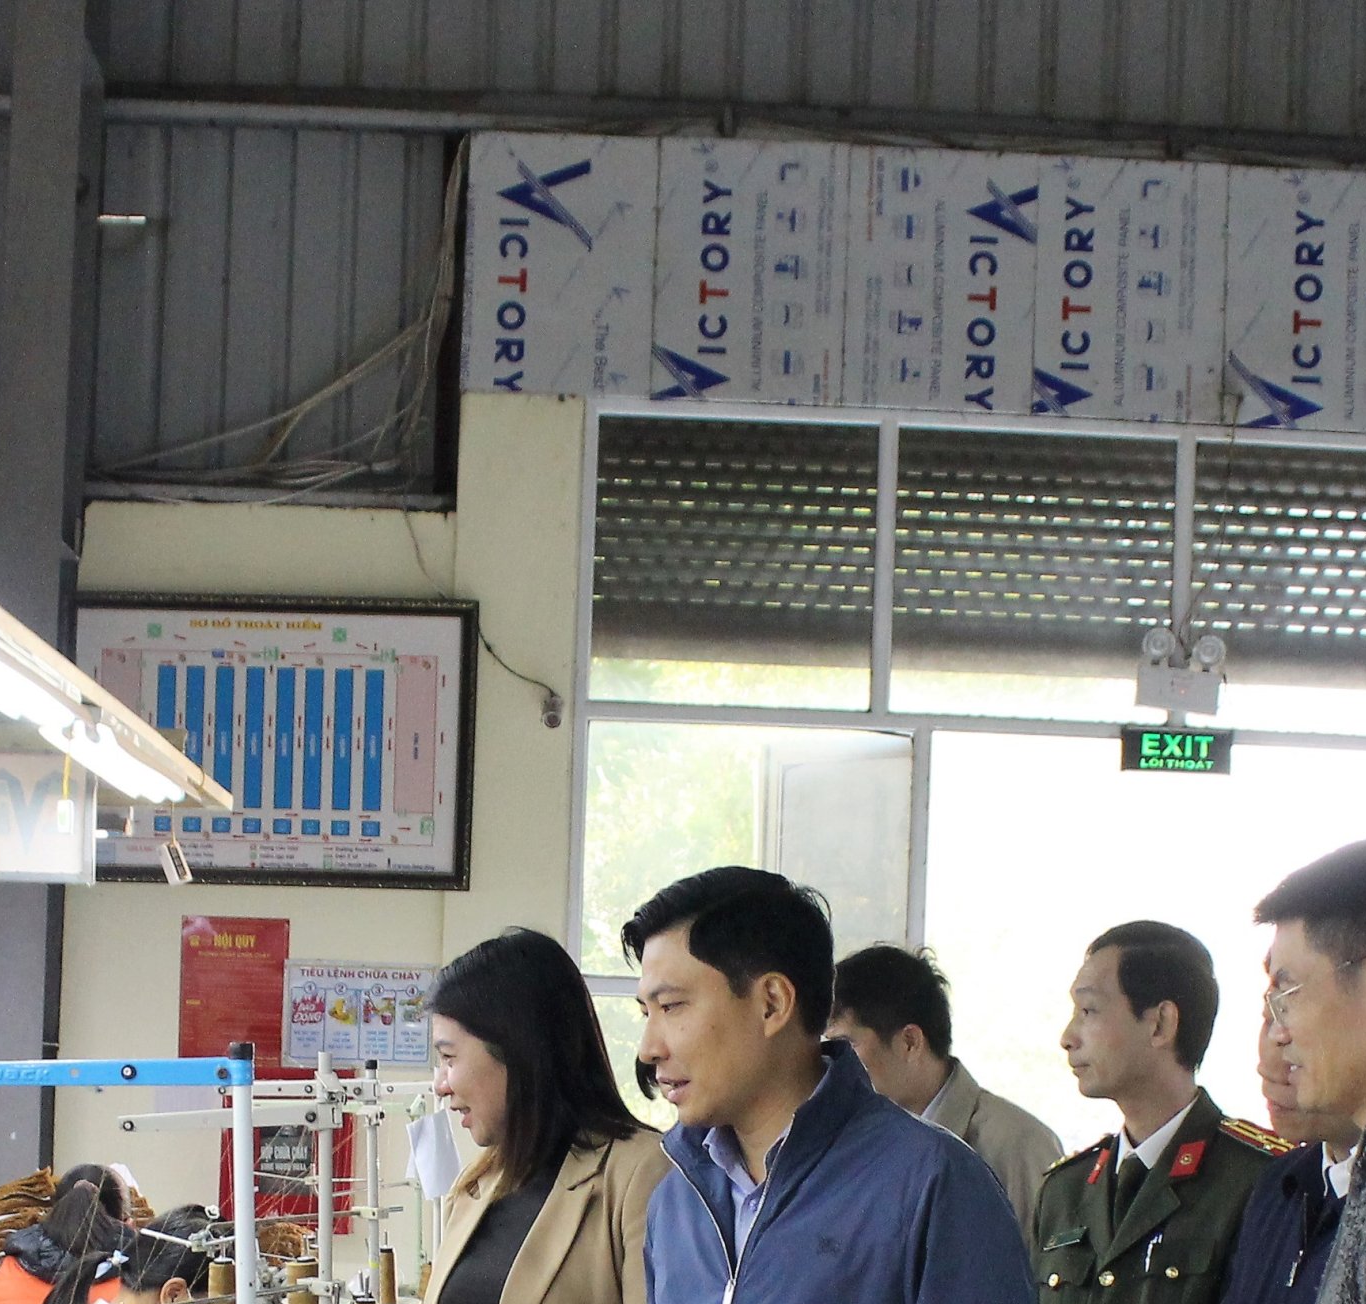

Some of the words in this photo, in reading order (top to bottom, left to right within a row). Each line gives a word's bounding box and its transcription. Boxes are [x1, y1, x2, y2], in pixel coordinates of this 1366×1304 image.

[492, 158, 593, 392] VICTORY
[649, 179, 732, 401] VICTORY
[964, 175, 1039, 411] VICTORY
[1032, 196, 1095, 414] VICTORY
[1229, 210, 1325, 430] VICTORY
[1141, 733, 1214, 758] EXIT
